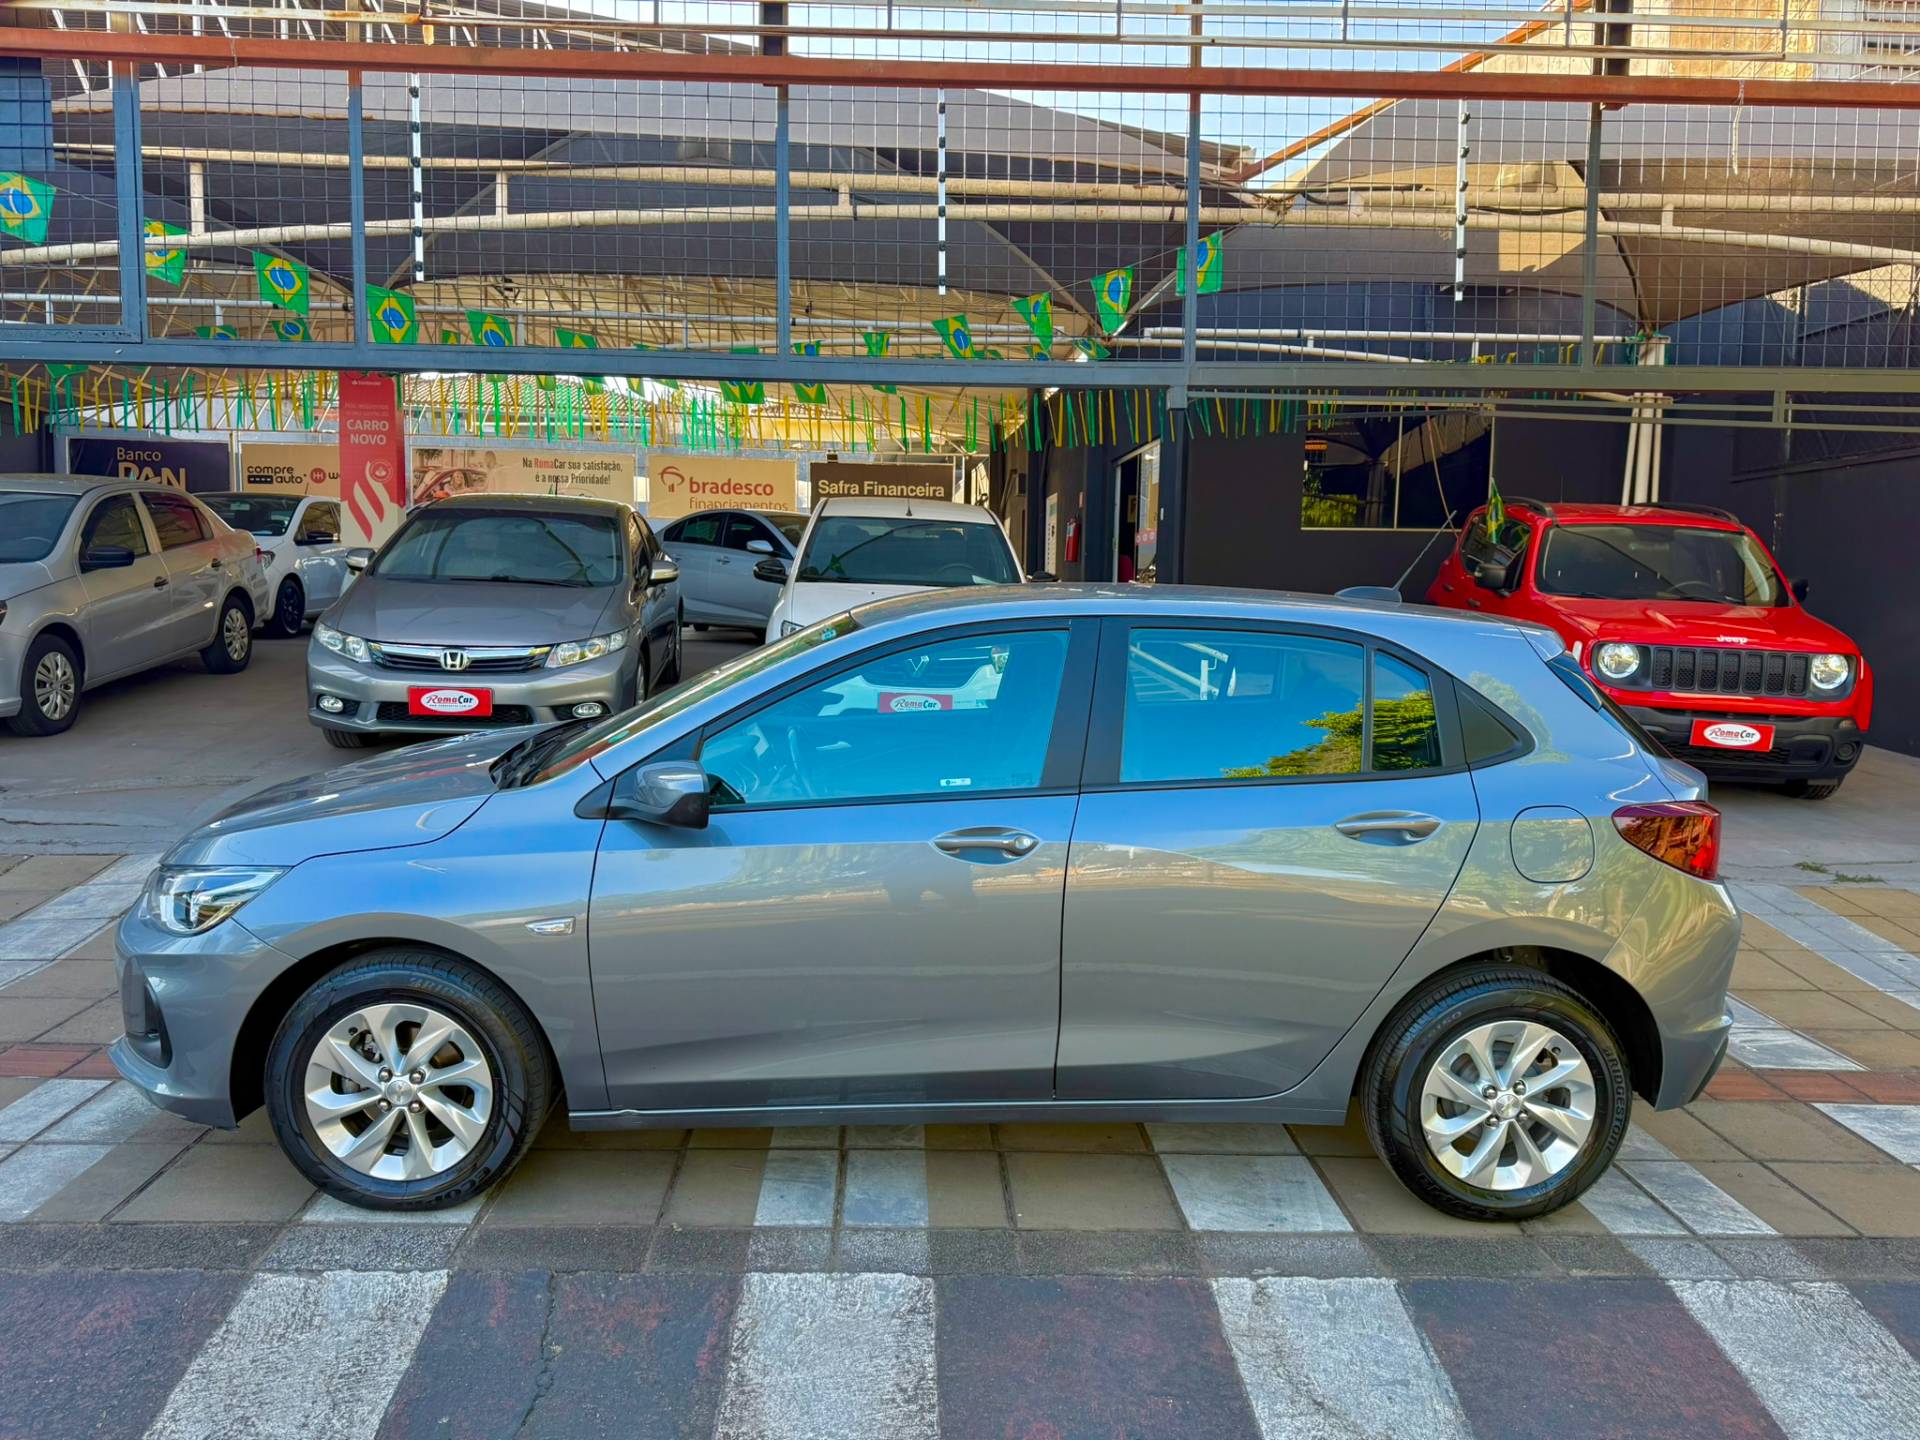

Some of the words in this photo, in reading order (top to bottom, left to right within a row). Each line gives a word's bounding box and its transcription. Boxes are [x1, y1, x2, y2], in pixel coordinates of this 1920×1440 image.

[346, 419, 389, 431] CARRO
[350, 433, 387, 445] NOVO
[117, 447, 161, 461] Banco
[523, 457, 532, 468] Na
[534, 458, 566, 470] RomaCar
[568, 462, 580, 470] sua
[247, 466, 294, 475] compre
[548, 475, 569, 483] nossa
[571, 473, 611, 485] Prioridade!
[689, 477, 774, 496] bradesco
[818, 480, 859, 495] Safra
[864, 481, 945, 497] Financeira
[689, 497, 788, 510] financiamentos
[1717, 634, 1748, 645] Jeep
[426, 694, 473, 704] RomaCar
[895, 699, 937, 708] RomaCar
[1709, 727, 1755, 738] RomaCar
